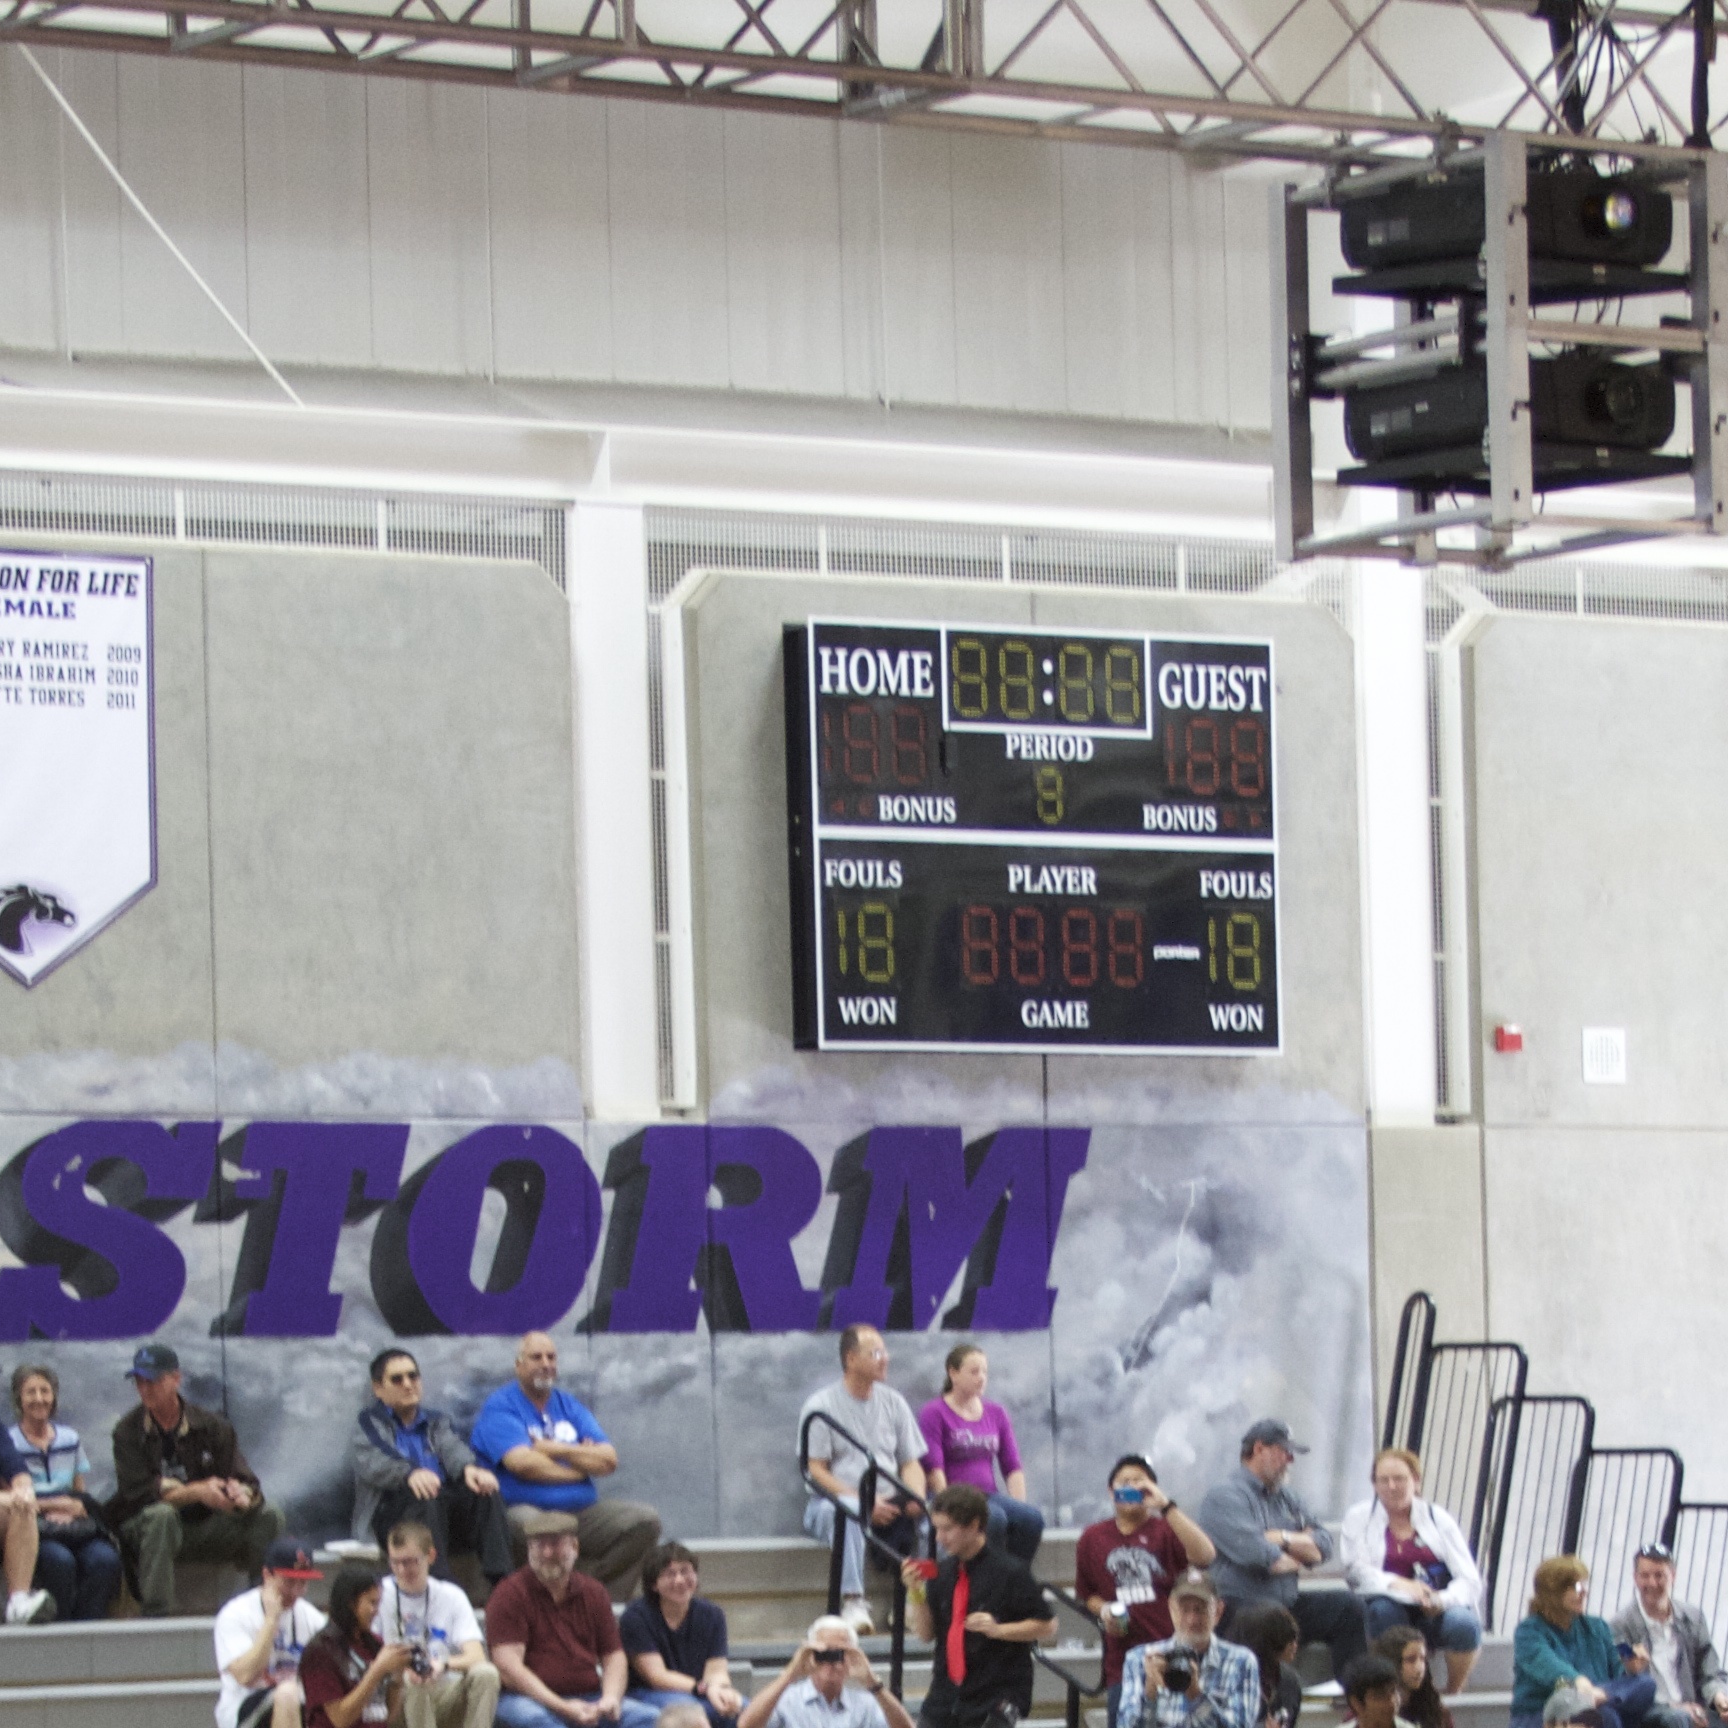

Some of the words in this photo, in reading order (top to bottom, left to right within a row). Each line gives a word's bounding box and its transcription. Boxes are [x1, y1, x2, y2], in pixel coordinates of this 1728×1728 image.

[37, 567, 81, 594] FOR
[86, 570, 140, 599] LIFE
[22, 641, 90, 662] RAMIREZ
[106, 644, 142, 664] 2009
[29, 663, 97, 685] IBRAHIM
[106, 667, 140, 687] 2010
[818, 646, 935, 698] HOME
[28, 687, 86, 708] TORRES
[106, 691, 137, 710] 2011
[1158, 662, 1268, 712] GUEST
[1004, 732, 1094, 762] PERIOD
[878, 795, 957, 824] BONUS
[1142, 804, 1217, 832] BONUS
[824, 859, 903, 888] FOULS
[1007, 864, 1098, 896] PLAYER
[1199, 870, 1273, 899] FOULS
[838, 996, 898, 1025] WON
[1020, 1000, 1090, 1029] GAME
[1208, 1003, 1265, 1032] WON
